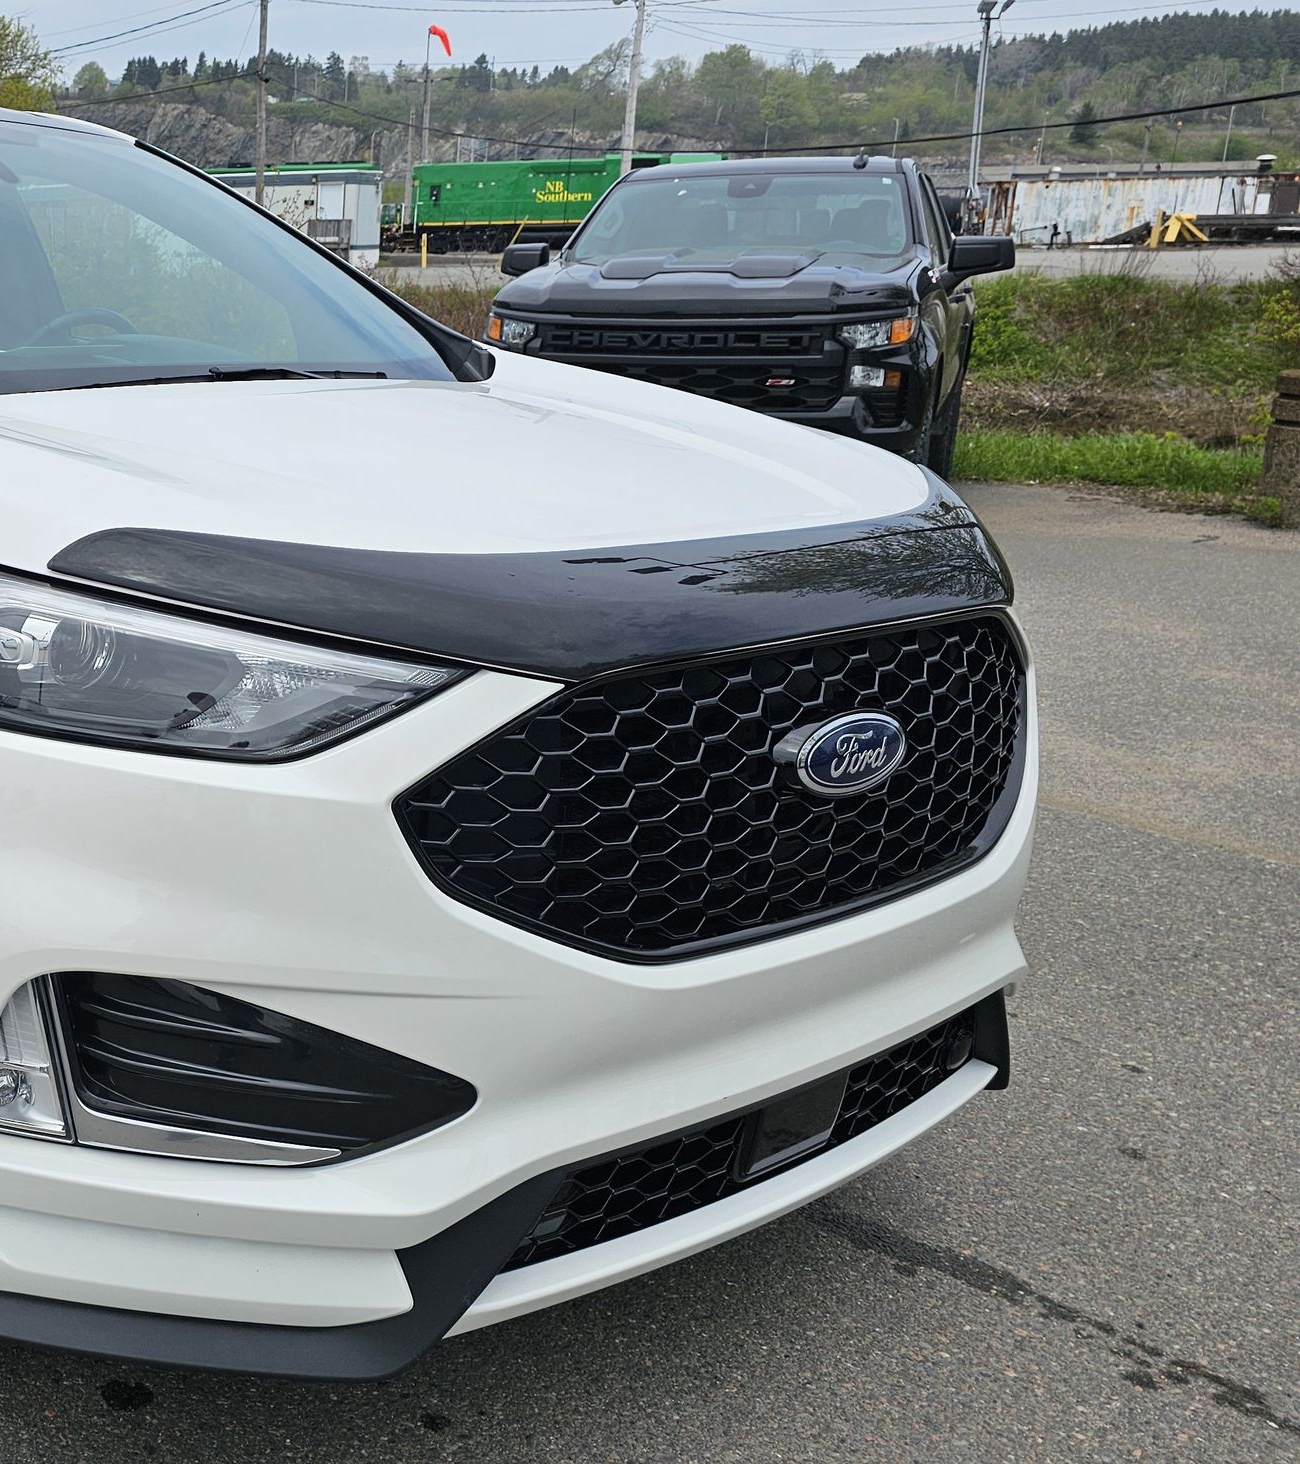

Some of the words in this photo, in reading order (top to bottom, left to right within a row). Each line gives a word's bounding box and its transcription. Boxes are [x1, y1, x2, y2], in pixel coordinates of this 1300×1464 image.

[545, 181, 564, 193] NB
[535, 191, 592, 203] Southern
[550, 331, 821, 349] CHEVROLET
[830, 730, 888, 778] Ford
